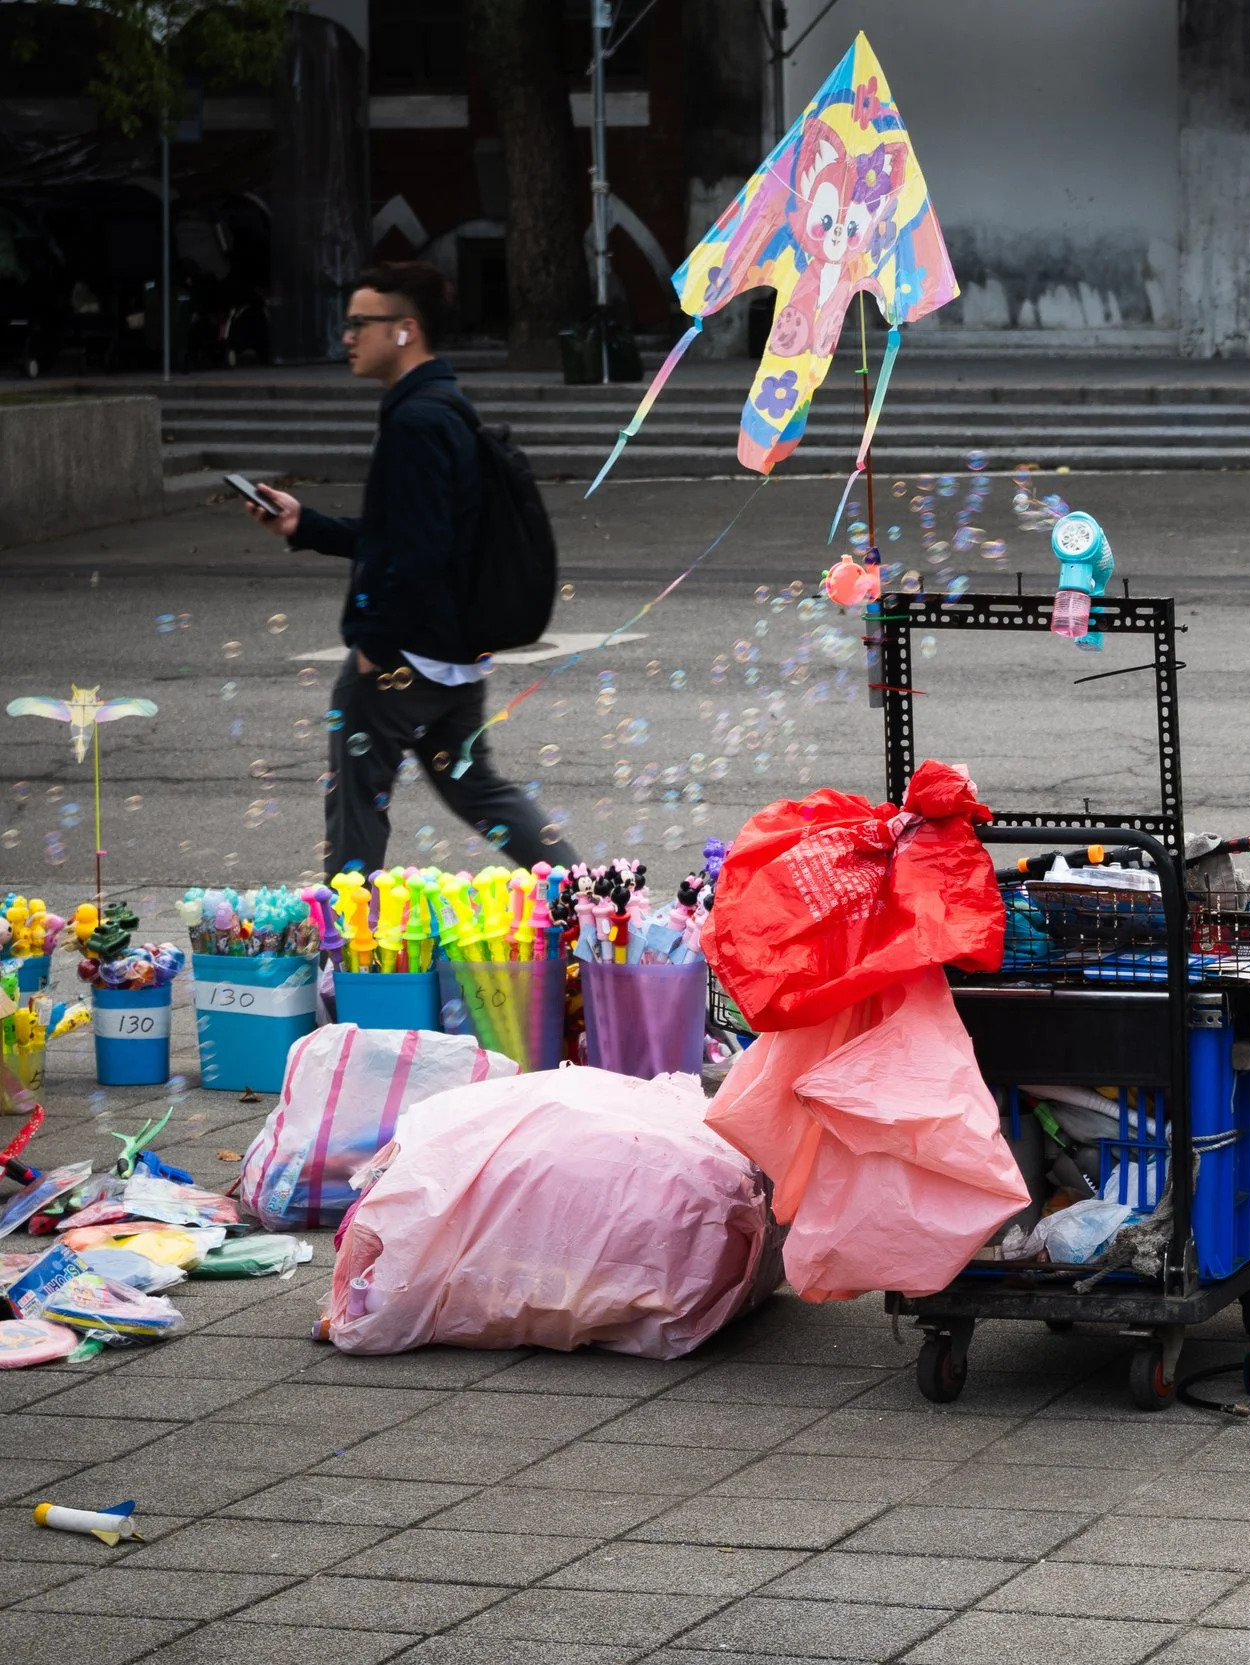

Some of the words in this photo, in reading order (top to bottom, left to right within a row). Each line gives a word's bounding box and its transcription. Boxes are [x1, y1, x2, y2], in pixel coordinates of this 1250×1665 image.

[210, 988, 255, 1008] 130
[461, 984, 506, 1010] 150
[119, 1015, 154, 1034] 130
